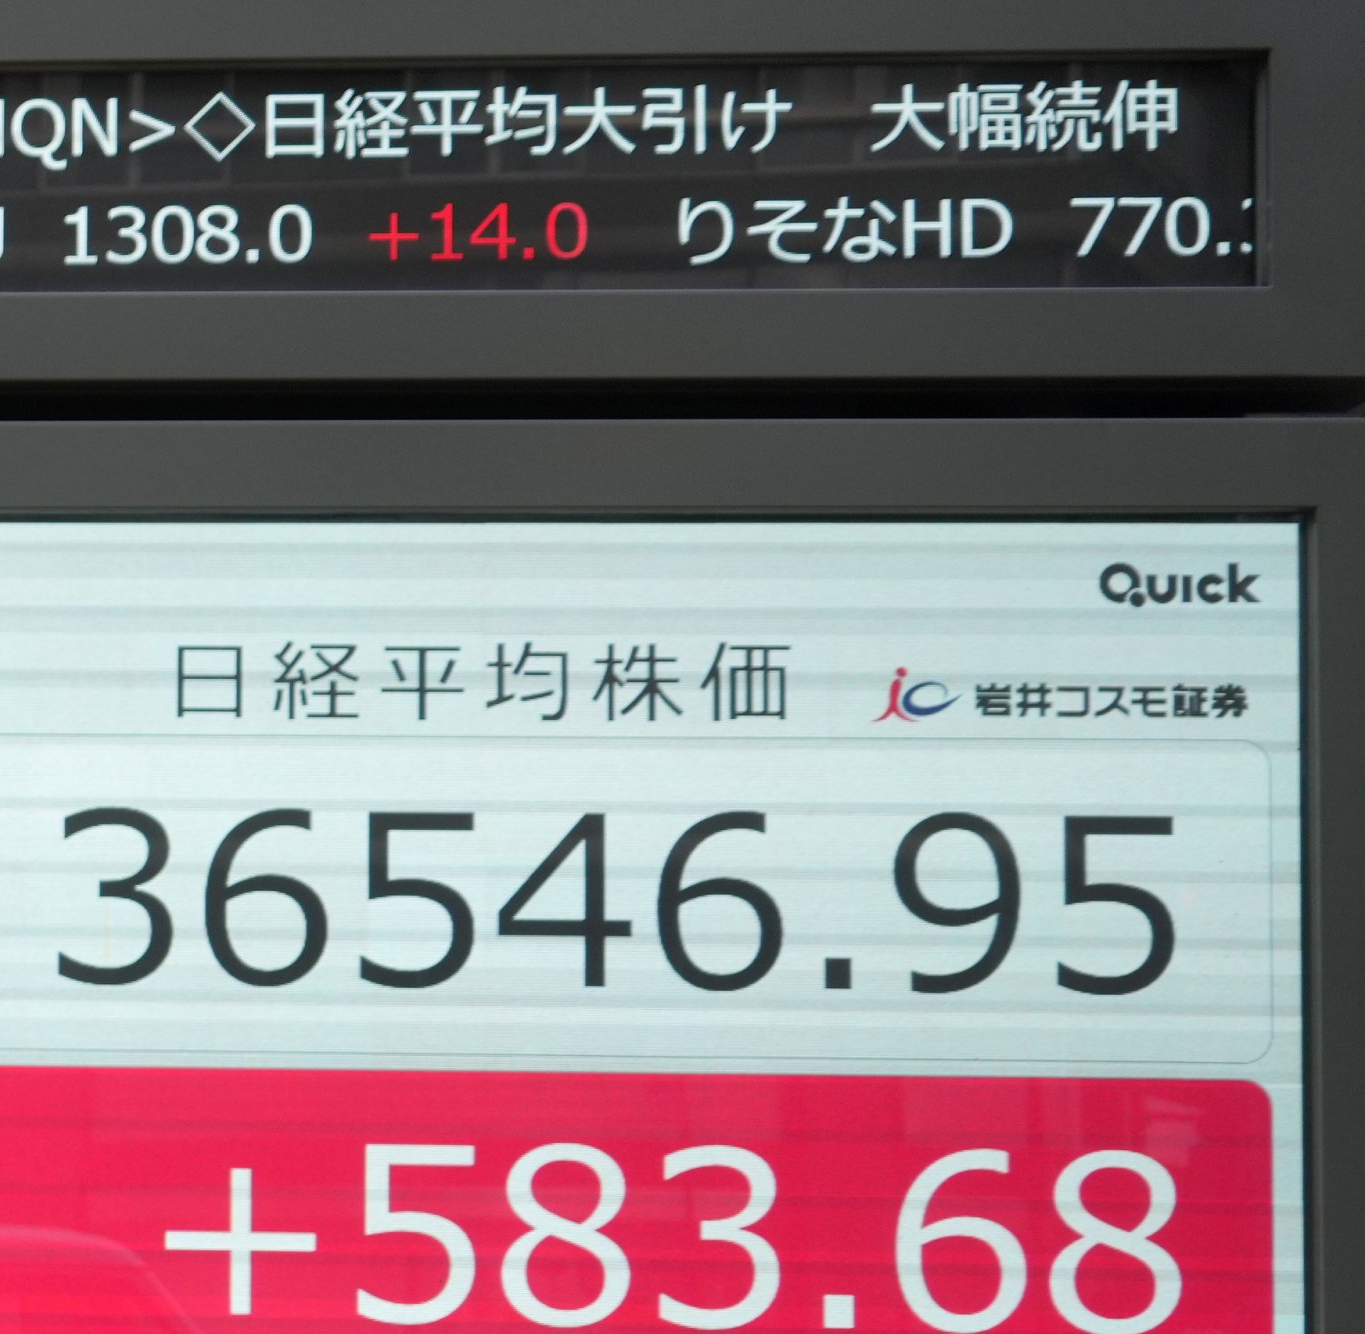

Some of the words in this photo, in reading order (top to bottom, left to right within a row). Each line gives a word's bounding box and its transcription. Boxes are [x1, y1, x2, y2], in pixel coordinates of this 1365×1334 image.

[871, 79, 1178, 152] 大幅続伸
[64, 204, 313, 265] 1308.0
[367, 201, 589, 262] +14.0
[678, 196, 1013, 265] りそなHD
[1070, 196, 1252, 256] 770.
[177, 641, 791, 722] 日経平均株価
[974, 681, 1249, 719] 岩井コスモ証券
[57, 806, 1177, 996] 36546.95
